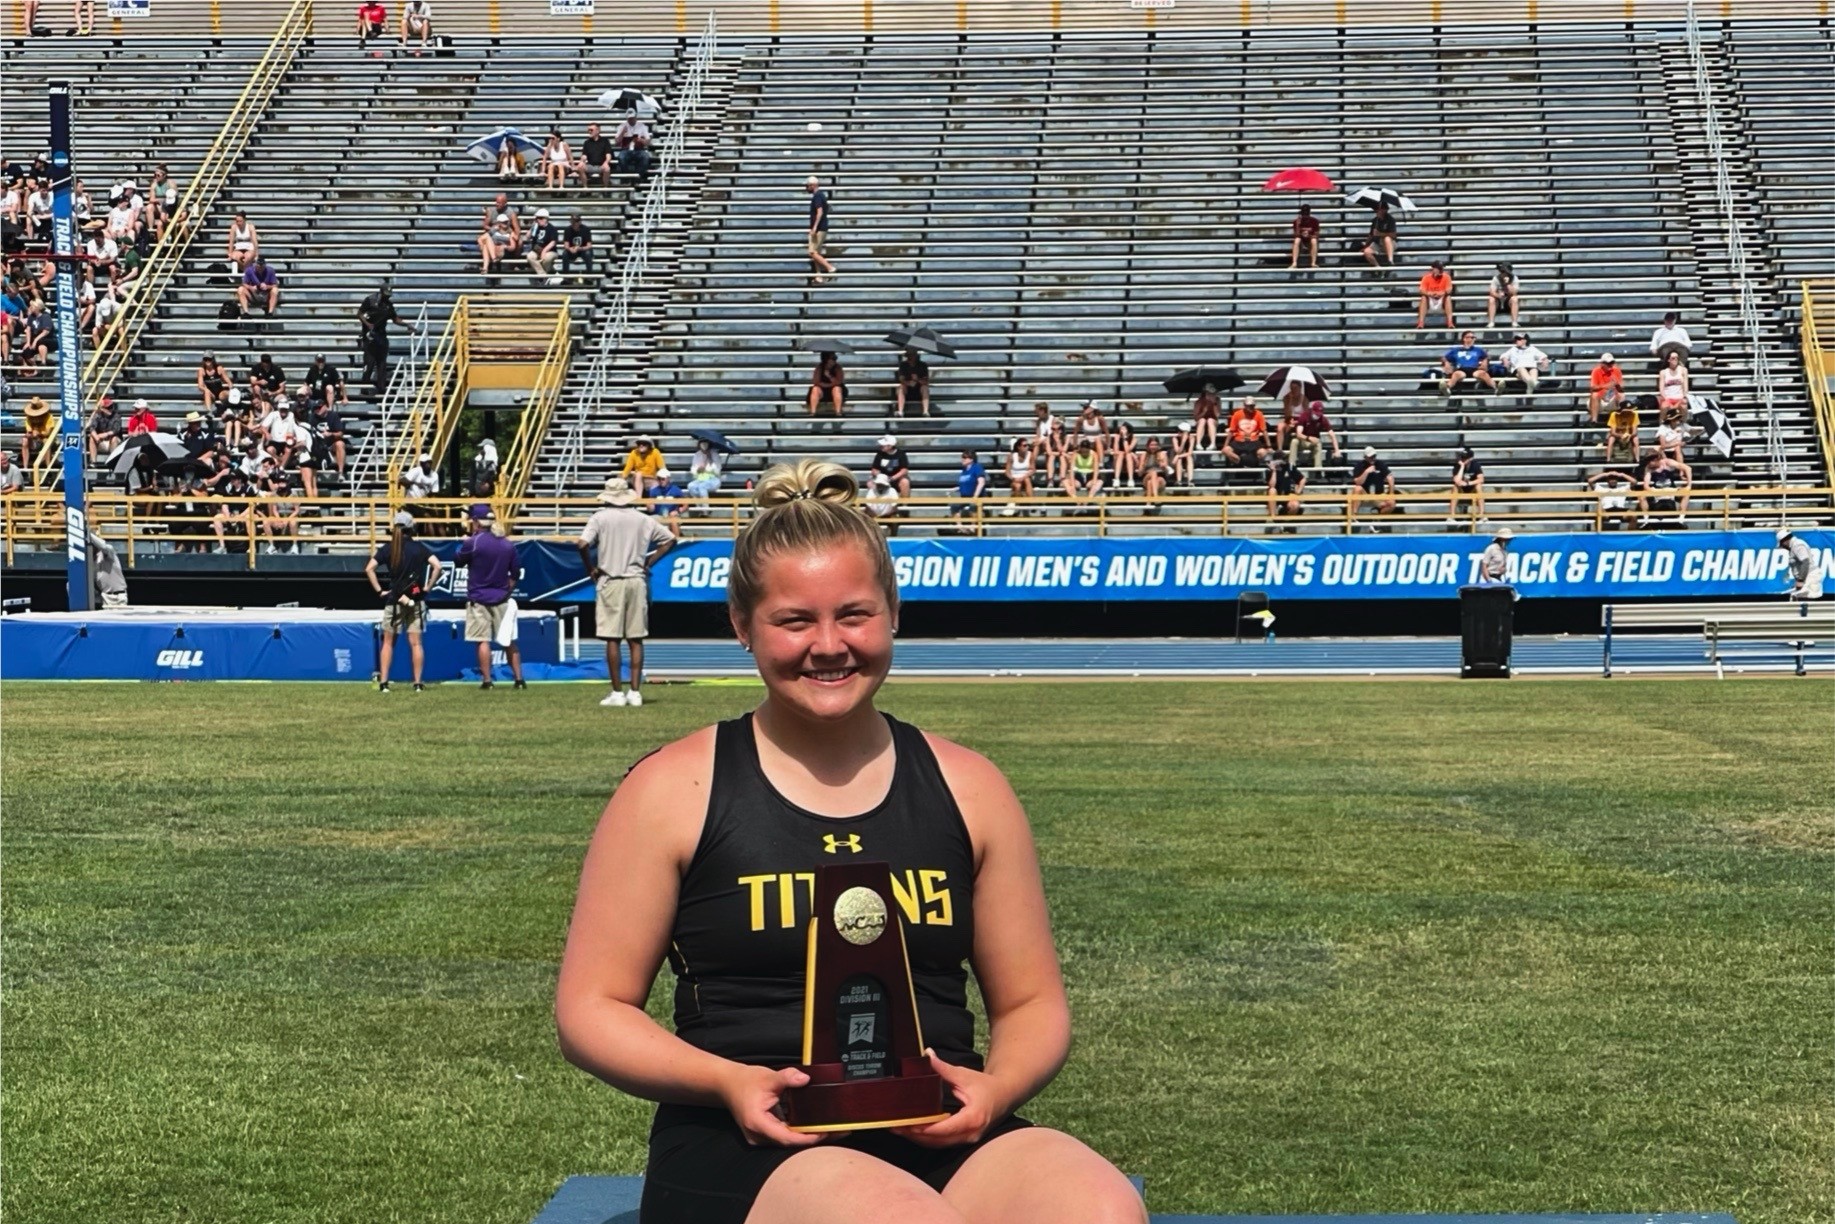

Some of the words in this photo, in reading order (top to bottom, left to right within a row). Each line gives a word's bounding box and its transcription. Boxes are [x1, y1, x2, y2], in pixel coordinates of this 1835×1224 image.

[59, 273, 73, 309] FIELD
[60, 310, 79, 421] CHAMPIONSHIPS
[67, 506, 86, 562] GILL
[670, 556, 731, 588] 202
[968, 556, 1001, 588] III
[1006, 555, 1101, 588] MEN'S
[1104, 554, 1168, 587] AND
[1174, 554, 1316, 587] WOMEN'S
[1321, 553, 1459, 586] OUTDOOR
[1467, 552, 1559, 584] TACK
[1565, 552, 1589, 584] &
[1594, 550, 1671, 583] FIELD
[156, 650, 204, 666] GILL
